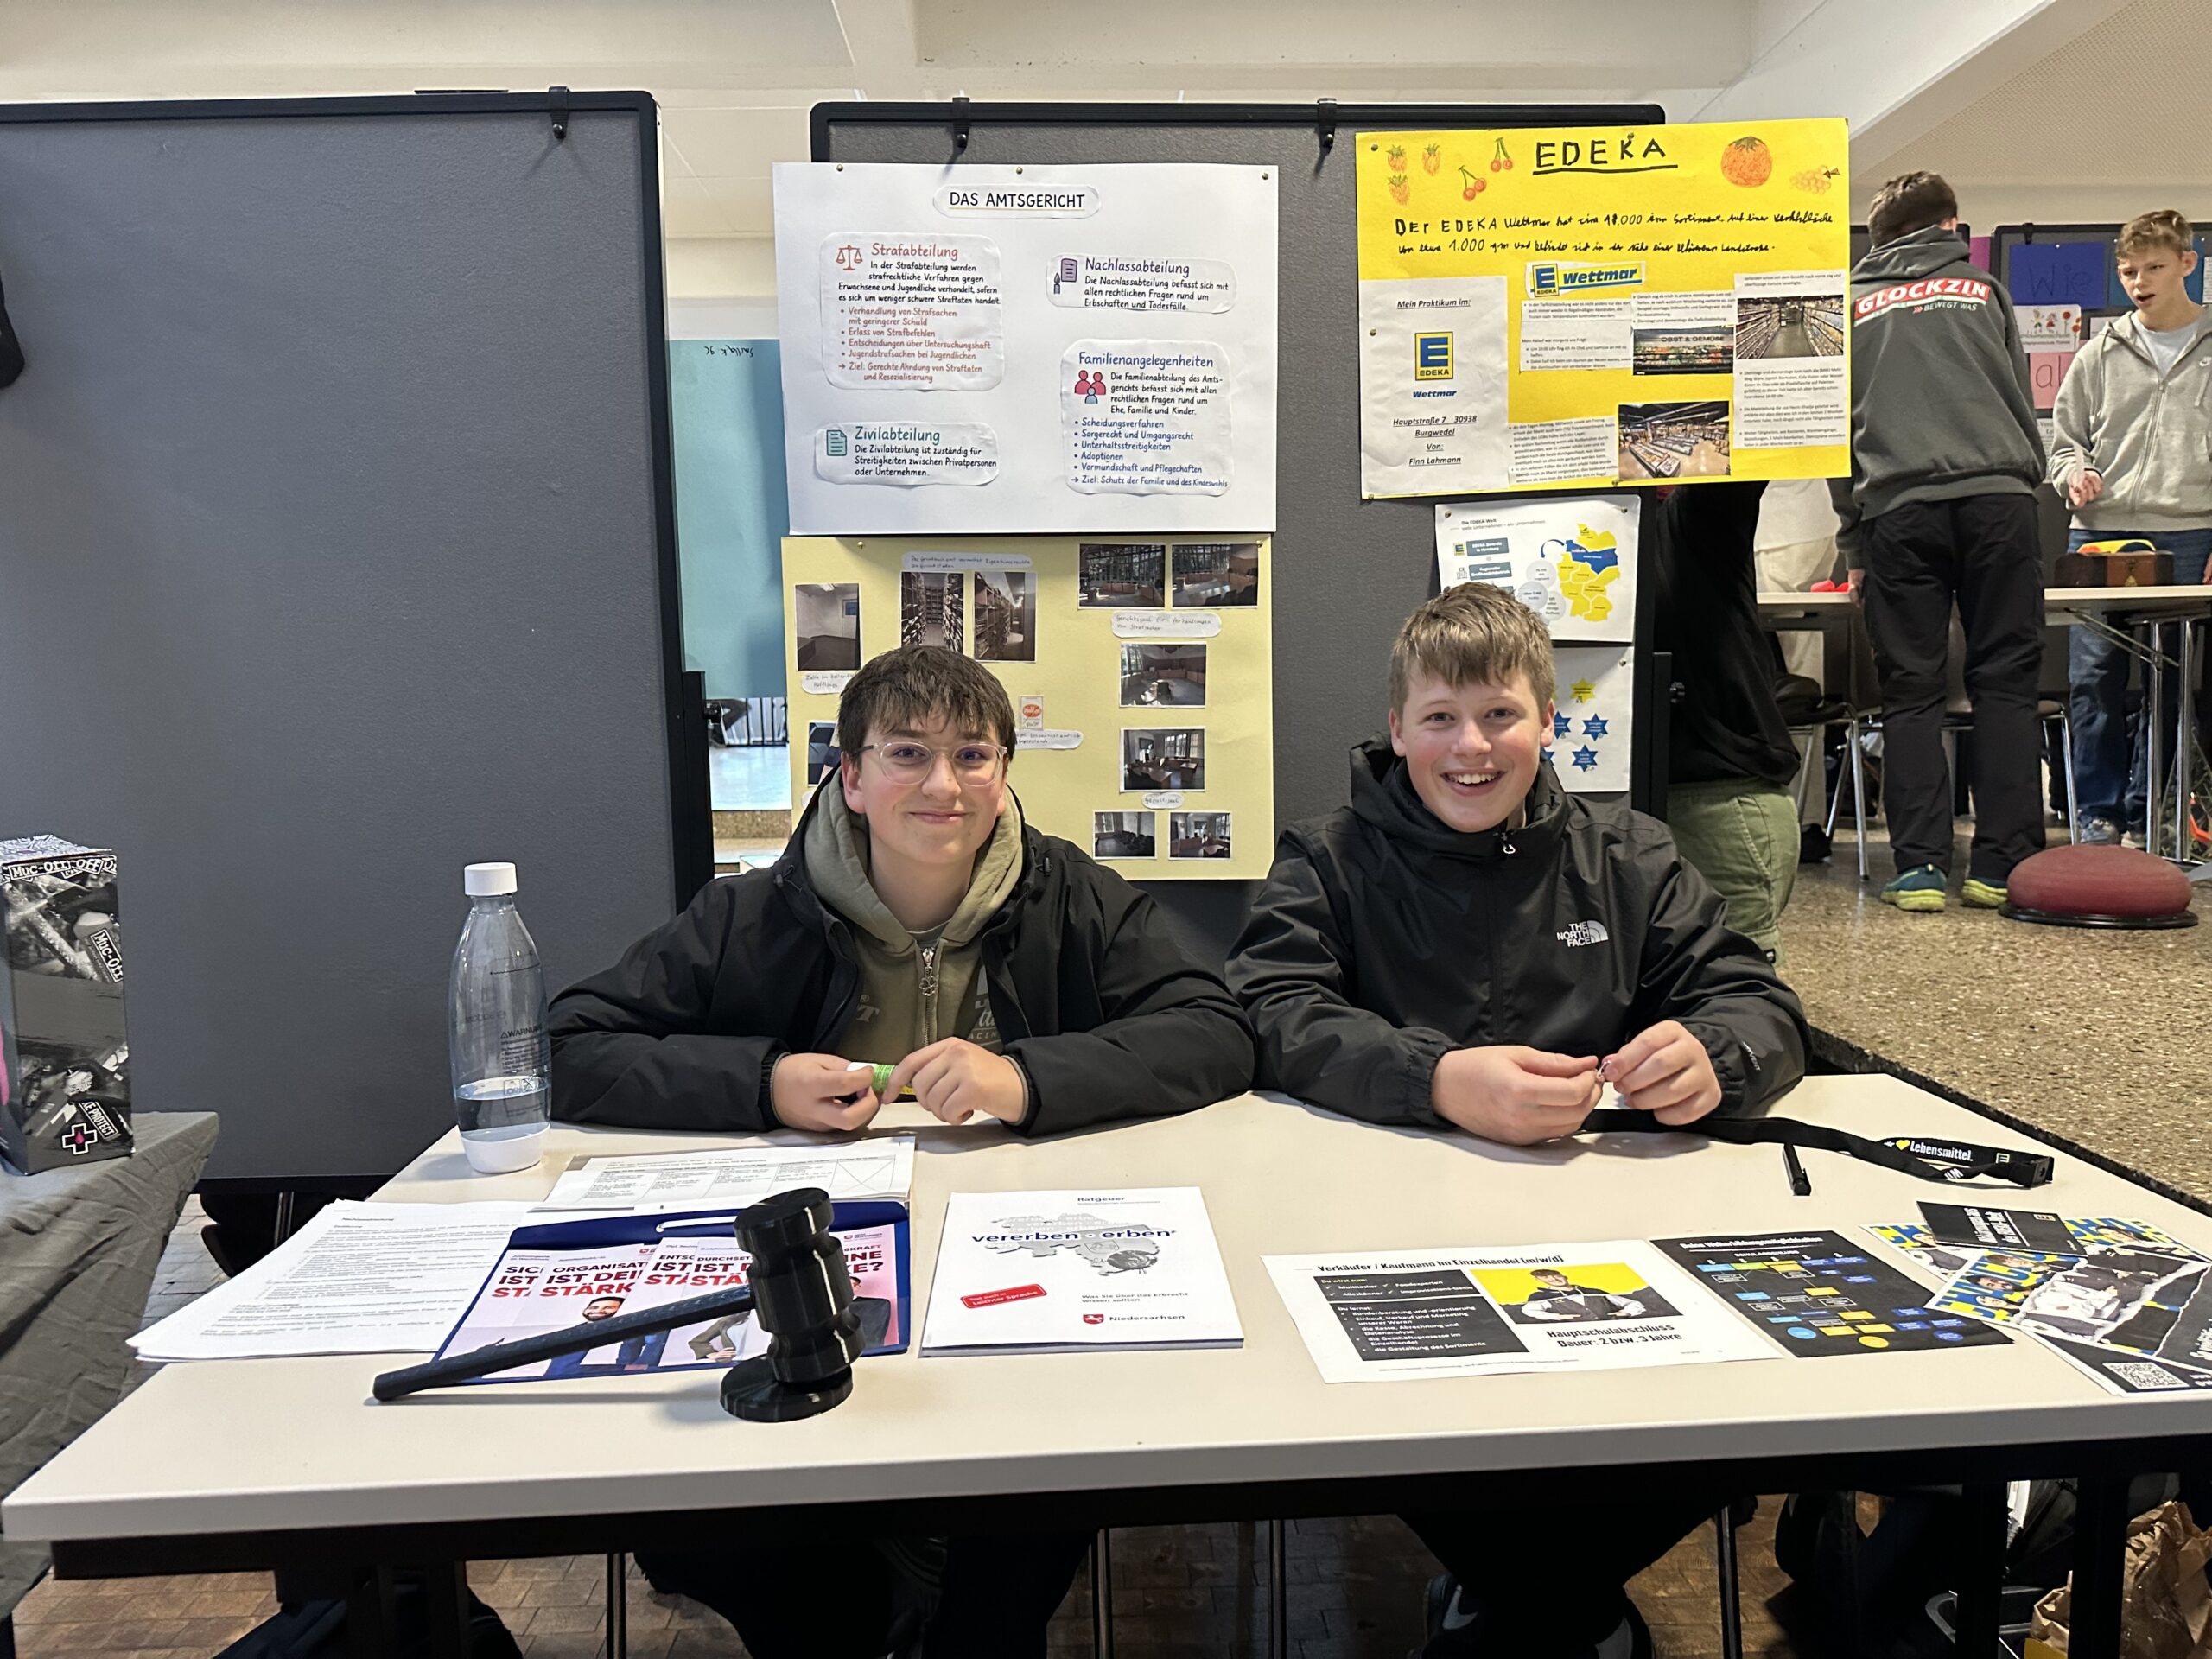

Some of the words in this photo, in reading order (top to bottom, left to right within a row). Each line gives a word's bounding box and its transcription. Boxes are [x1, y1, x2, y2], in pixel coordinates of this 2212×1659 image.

[1536, 138, 1666, 168] EDEKA
[950, 192, 978, 206] DAS
[986, 193, 1085, 207] AMTSGERICHT
[1441, 217, 1497, 232] EDEKA
[1449, 238, 1484, 251] 1.000
[871, 243, 958, 261] Strafabteilung
[895, 261, 948, 272] Strafabteilung
[1085, 257, 1190, 278] Nachlassabteilung
[924, 274, 959, 283] Verfahren
[1563, 267, 1637, 285] Wettmar
[2029, 263, 2092, 298] Wie
[1085, 276, 1096, 285] Die
[1100, 276, 1169, 289] Nachlassabteilung
[1172, 279, 1198, 289] befasst
[897, 284, 936, 294] Jugendliche
[1858, 279, 1986, 314] GLOCKZIN
[1084, 298, 1129, 308] Erbschaften
[1923, 302, 1957, 311] BEWEGT
[849, 307, 896, 318] Verhandlung
[887, 329, 935, 338] Strafbefehlen
[849, 339, 905, 348] Entscheidungen
[925, 340, 991, 351] Untersuchungshaft
[848, 350, 916, 359] Jugendstrafsachen
[930, 351, 976, 360] Jugendlichen
[1079, 352, 1213, 370] Familienangelegenheiten
[899, 364, 931, 373] Ahndung
[946, 364, 982, 372] Straftaten
[878, 373, 933, 383] Resozialisierung
[1111, 372, 1122, 381] Die
[1124, 372, 1186, 385] Familienabteilung
[1189, 374, 1200, 383] des
[1202, 375, 1223, 384] Amts-
[1172, 407, 1197, 416] Kinder.
[1082, 418, 1164, 429] Scheidungsverfahren
[1393, 417, 1440, 426] Hauptstraße
[855, 426, 940, 445] Zivilabteilung
[1081, 430, 1122, 442] Sorgerecht
[1141, 431, 1194, 442] Umgangsrecht
[1414, 429, 1455, 437] Burgwedel
[869, 444, 919, 455] Zivilabteilung
[933, 447, 968, 457] zuständig
[1081, 442, 1171, 452] Unterhaltsstreitigkeiten
[855, 455, 906, 467] Streitigkeiten
[945, 458, 996, 469] Privatpersonen
[1081, 454, 1123, 463] Adoptionen
[1193, 479, 1228, 487] Kindeswohls
[1568, 921, 1587, 931] THE
[1556, 929, 1589, 940] NORTH
[1567, 937, 1591, 947] FACE
[90, 1109, 115, 1136] PROTECT
[1910, 1141, 1974, 1161] Lebensmittel.
[972, 1232, 1079, 1242] vererben
[553, 1262, 648, 1273] ORGANISAT
[652, 1262, 692, 1271] IST
[695, 1263, 734, 1272] IST
[1318, 1263, 1371, 1272] Verkäufer
[1381, 1261, 1436, 1269] Kaufmann
[499, 1275, 538, 1285] IST
[546, 1274, 588, 1284] IST
[1547, 1324, 1675, 1338] Hauptschulabschluss
[1610, 1336, 1637, 1344] bzw.
